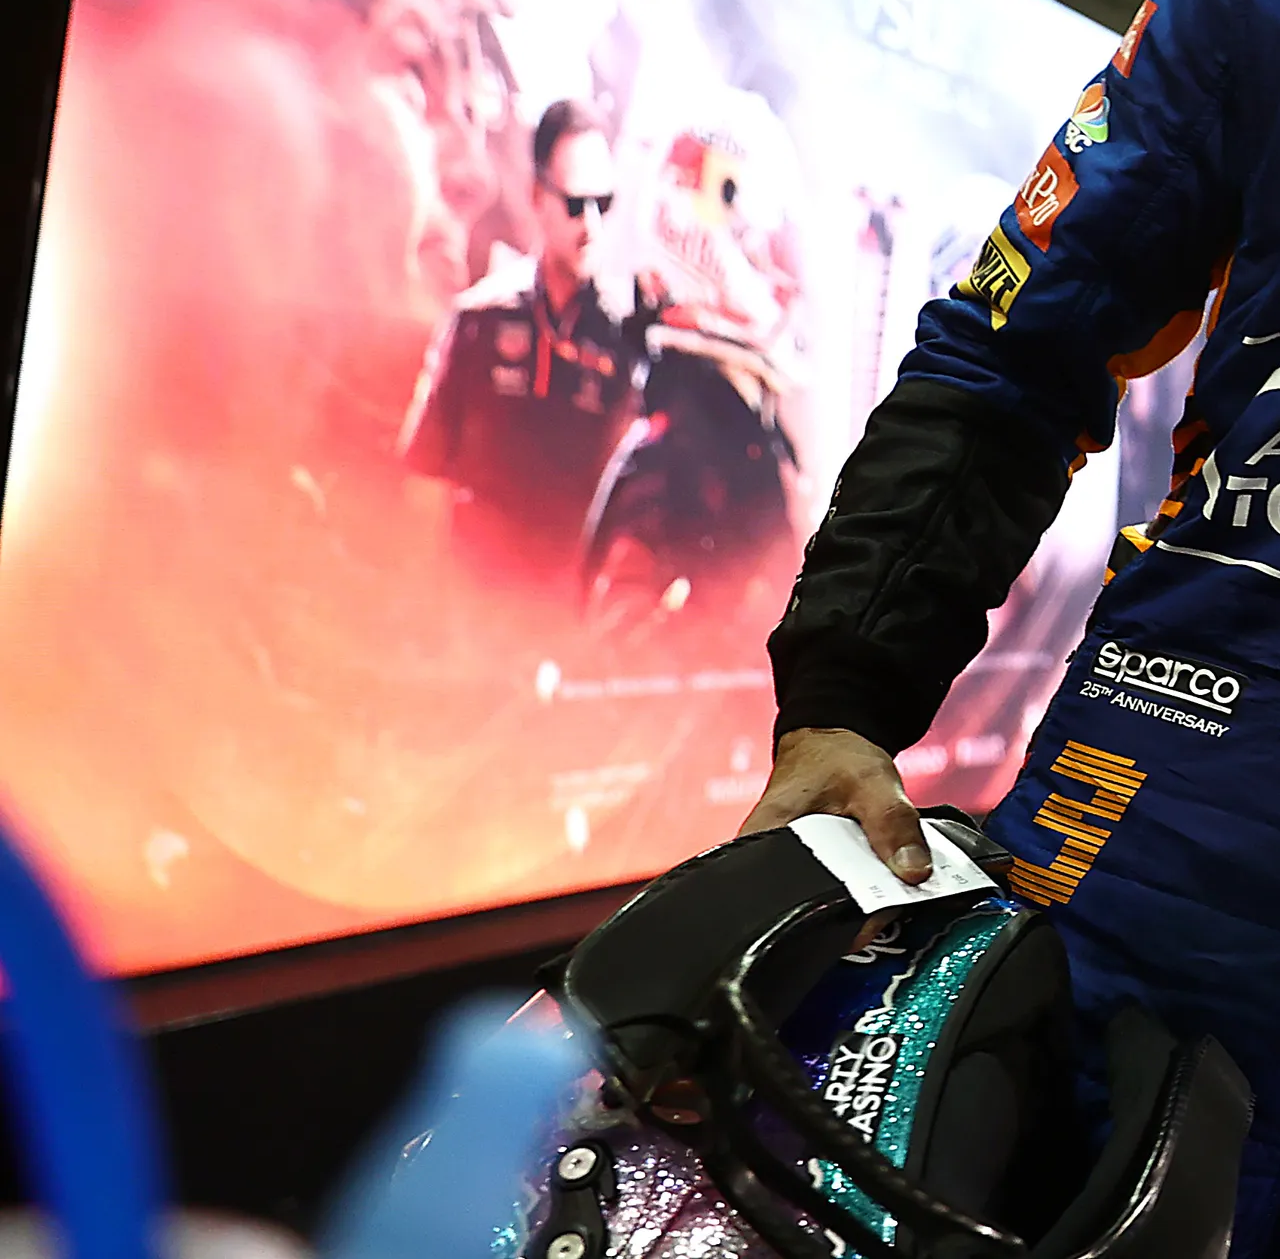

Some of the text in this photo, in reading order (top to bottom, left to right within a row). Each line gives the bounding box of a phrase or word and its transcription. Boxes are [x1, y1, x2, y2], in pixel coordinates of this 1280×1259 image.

[1098, 641, 1241, 705] sparco
[1079, 680, 1230, 738] 25TH ANNIVERSARY
[847, 1037, 897, 1143] ASINO
